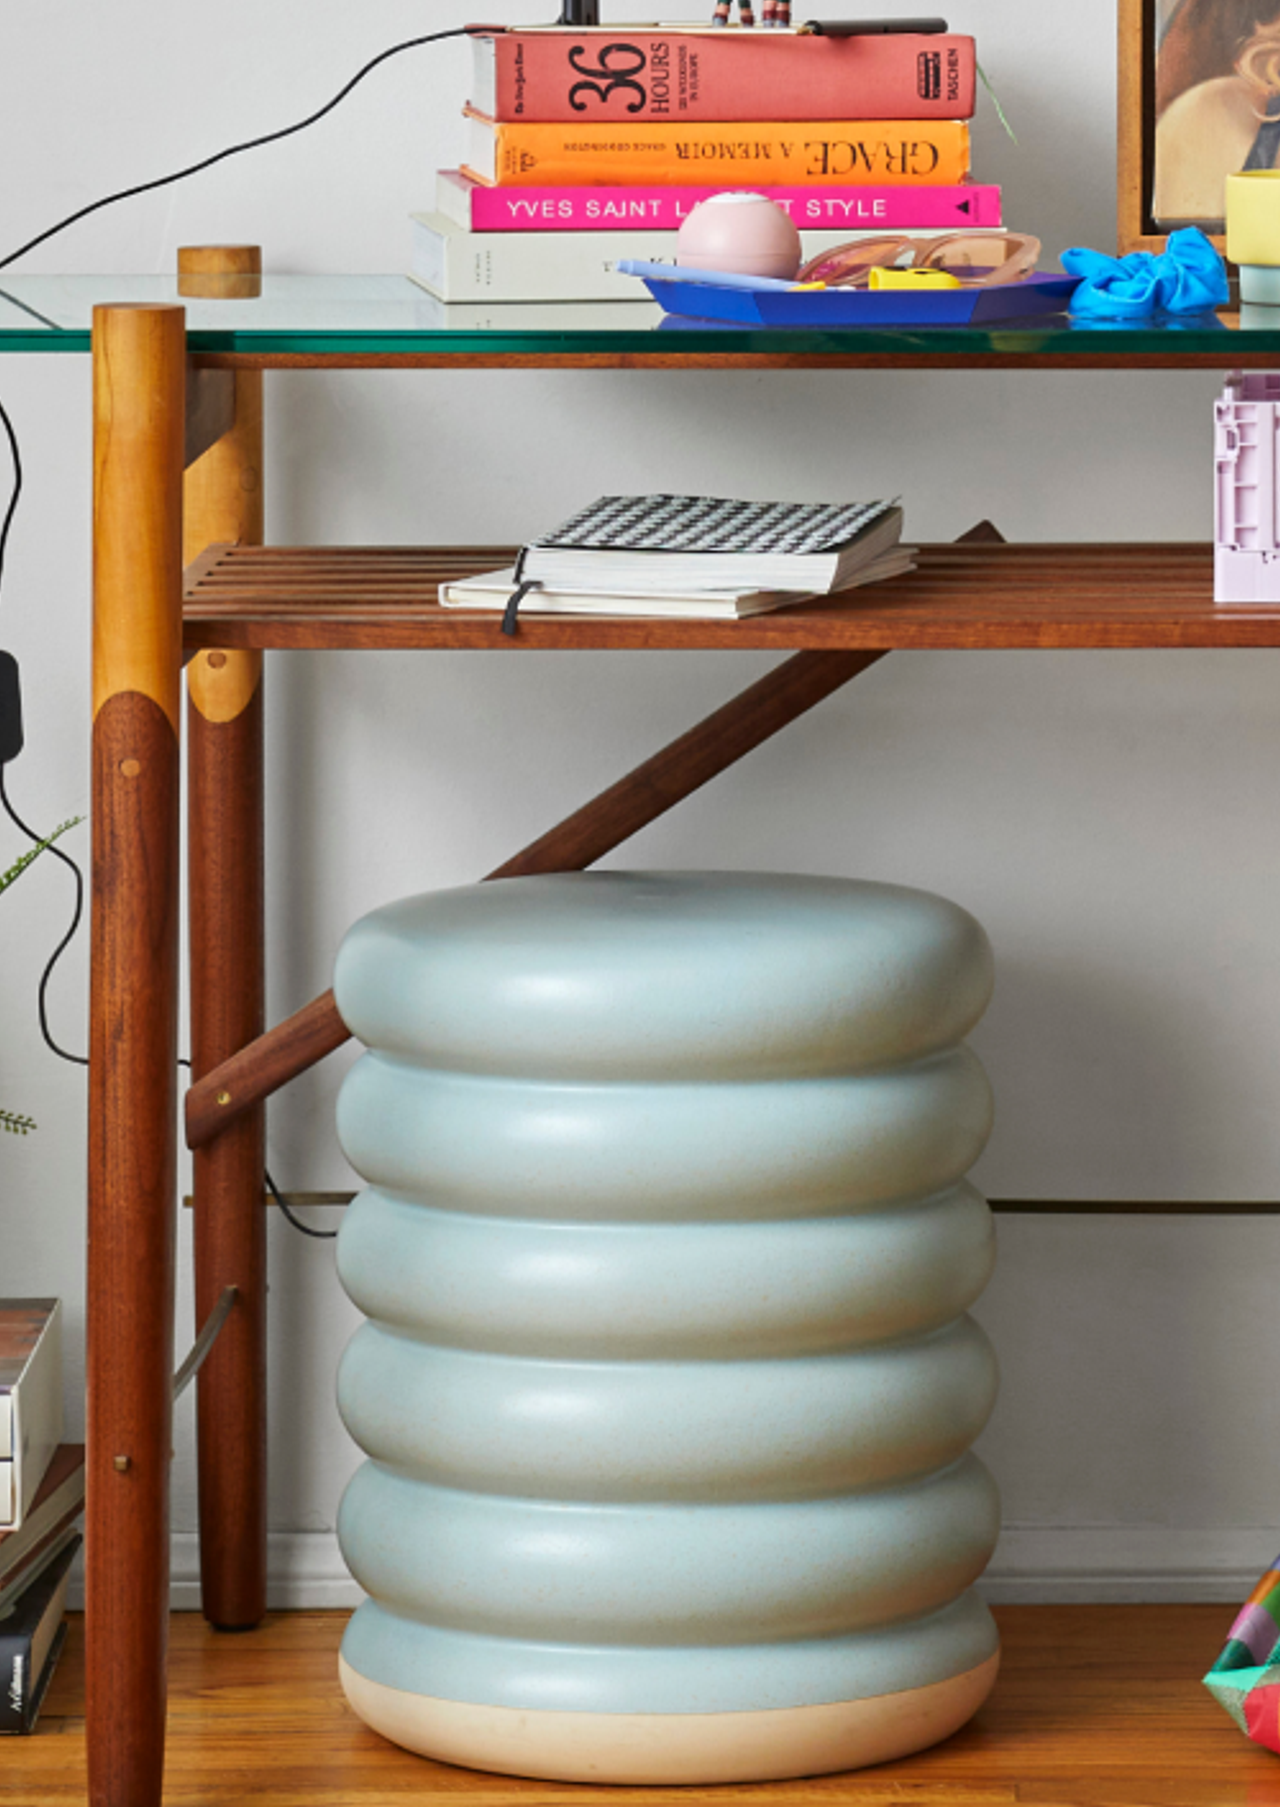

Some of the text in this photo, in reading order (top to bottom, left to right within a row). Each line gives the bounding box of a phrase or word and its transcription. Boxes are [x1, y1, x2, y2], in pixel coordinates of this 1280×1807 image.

[567, 43, 647, 114] 36
[650, 41, 670, 114] HOURS
[947, 47, 960, 102] TASCHEN
[675, 142, 771, 160] MEMOIR
[779, 142, 795, 159] A
[805, 141, 939, 175] GRACE
[506, 199, 573, 218] YVES
[585, 199, 662, 218] SAINT
[806, 198, 886, 218] STYLE
